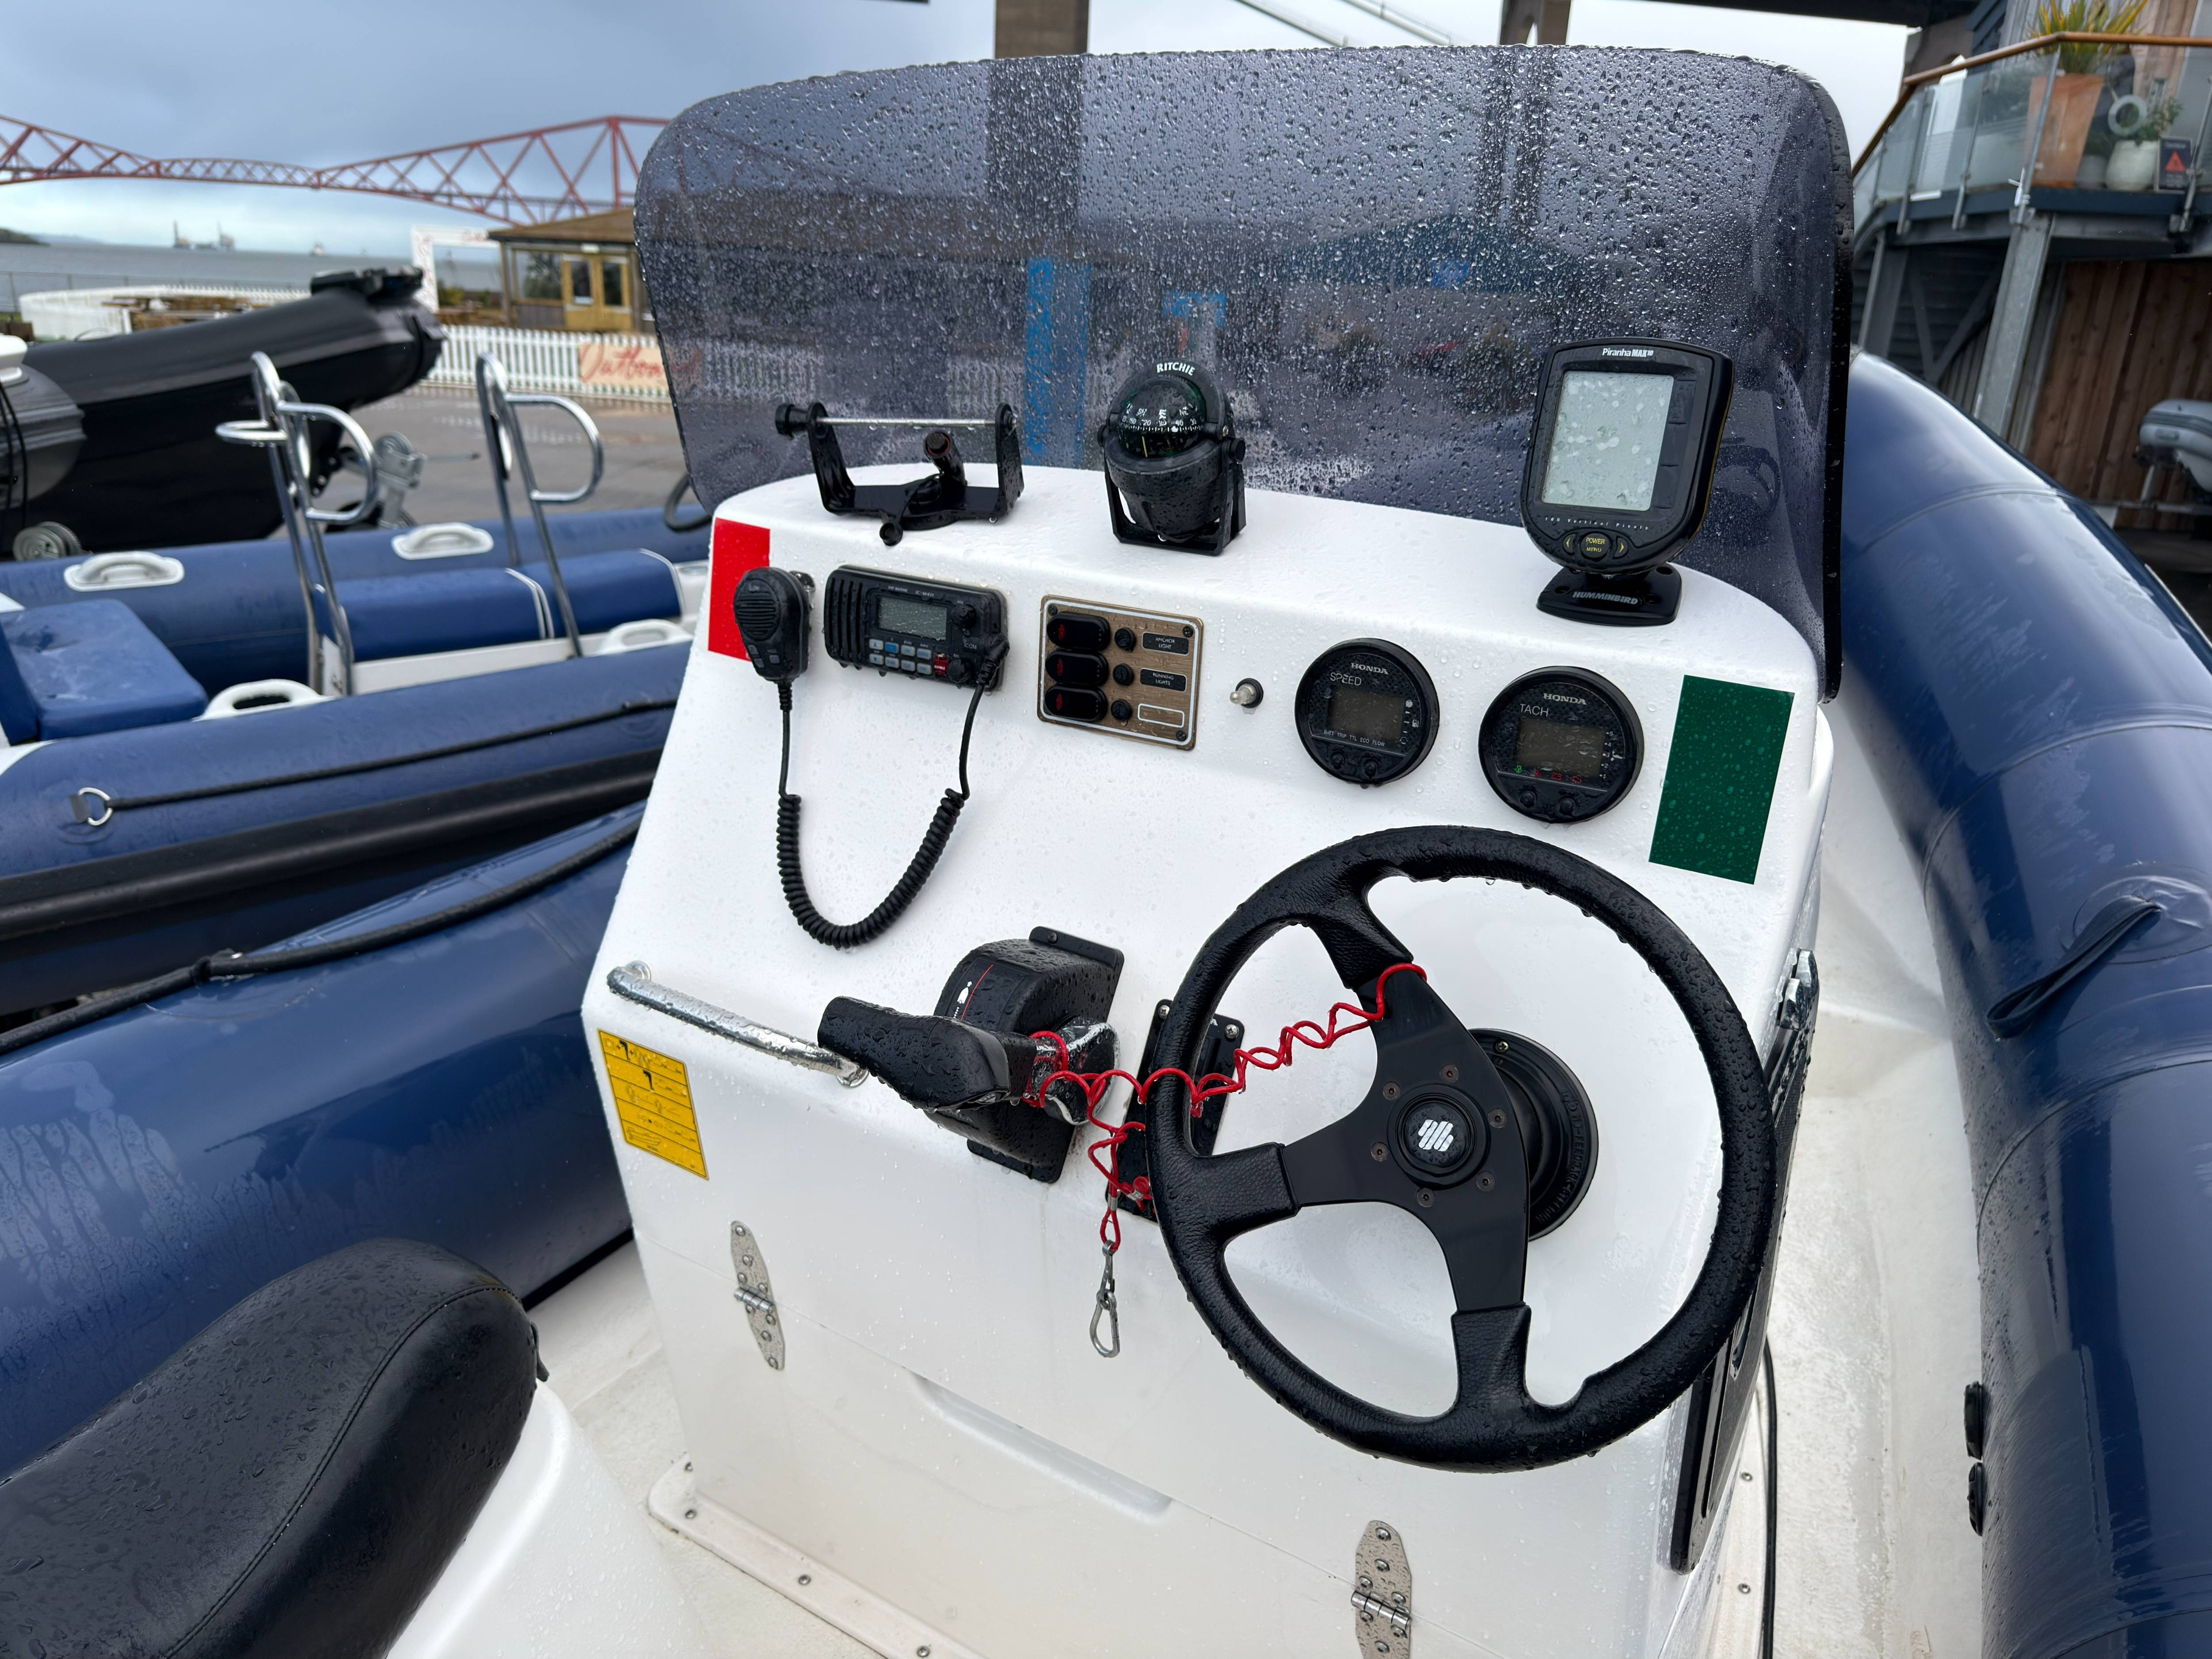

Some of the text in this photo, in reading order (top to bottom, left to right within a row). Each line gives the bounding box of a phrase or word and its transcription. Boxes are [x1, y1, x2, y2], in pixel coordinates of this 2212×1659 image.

[1602, 348, 1631, 357] Piranha
[1156, 362, 1195, 376] RITCHIE
[1567, 518, 1609, 526] Vertical
[1572, 591, 1639, 605] HUMMINBIRD
[1351, 663, 1389, 675] HONDA
[1330, 672, 1362, 686] SPEED
[1543, 693, 1587, 705] HONDA
[1520, 703, 1549, 717] TACH
